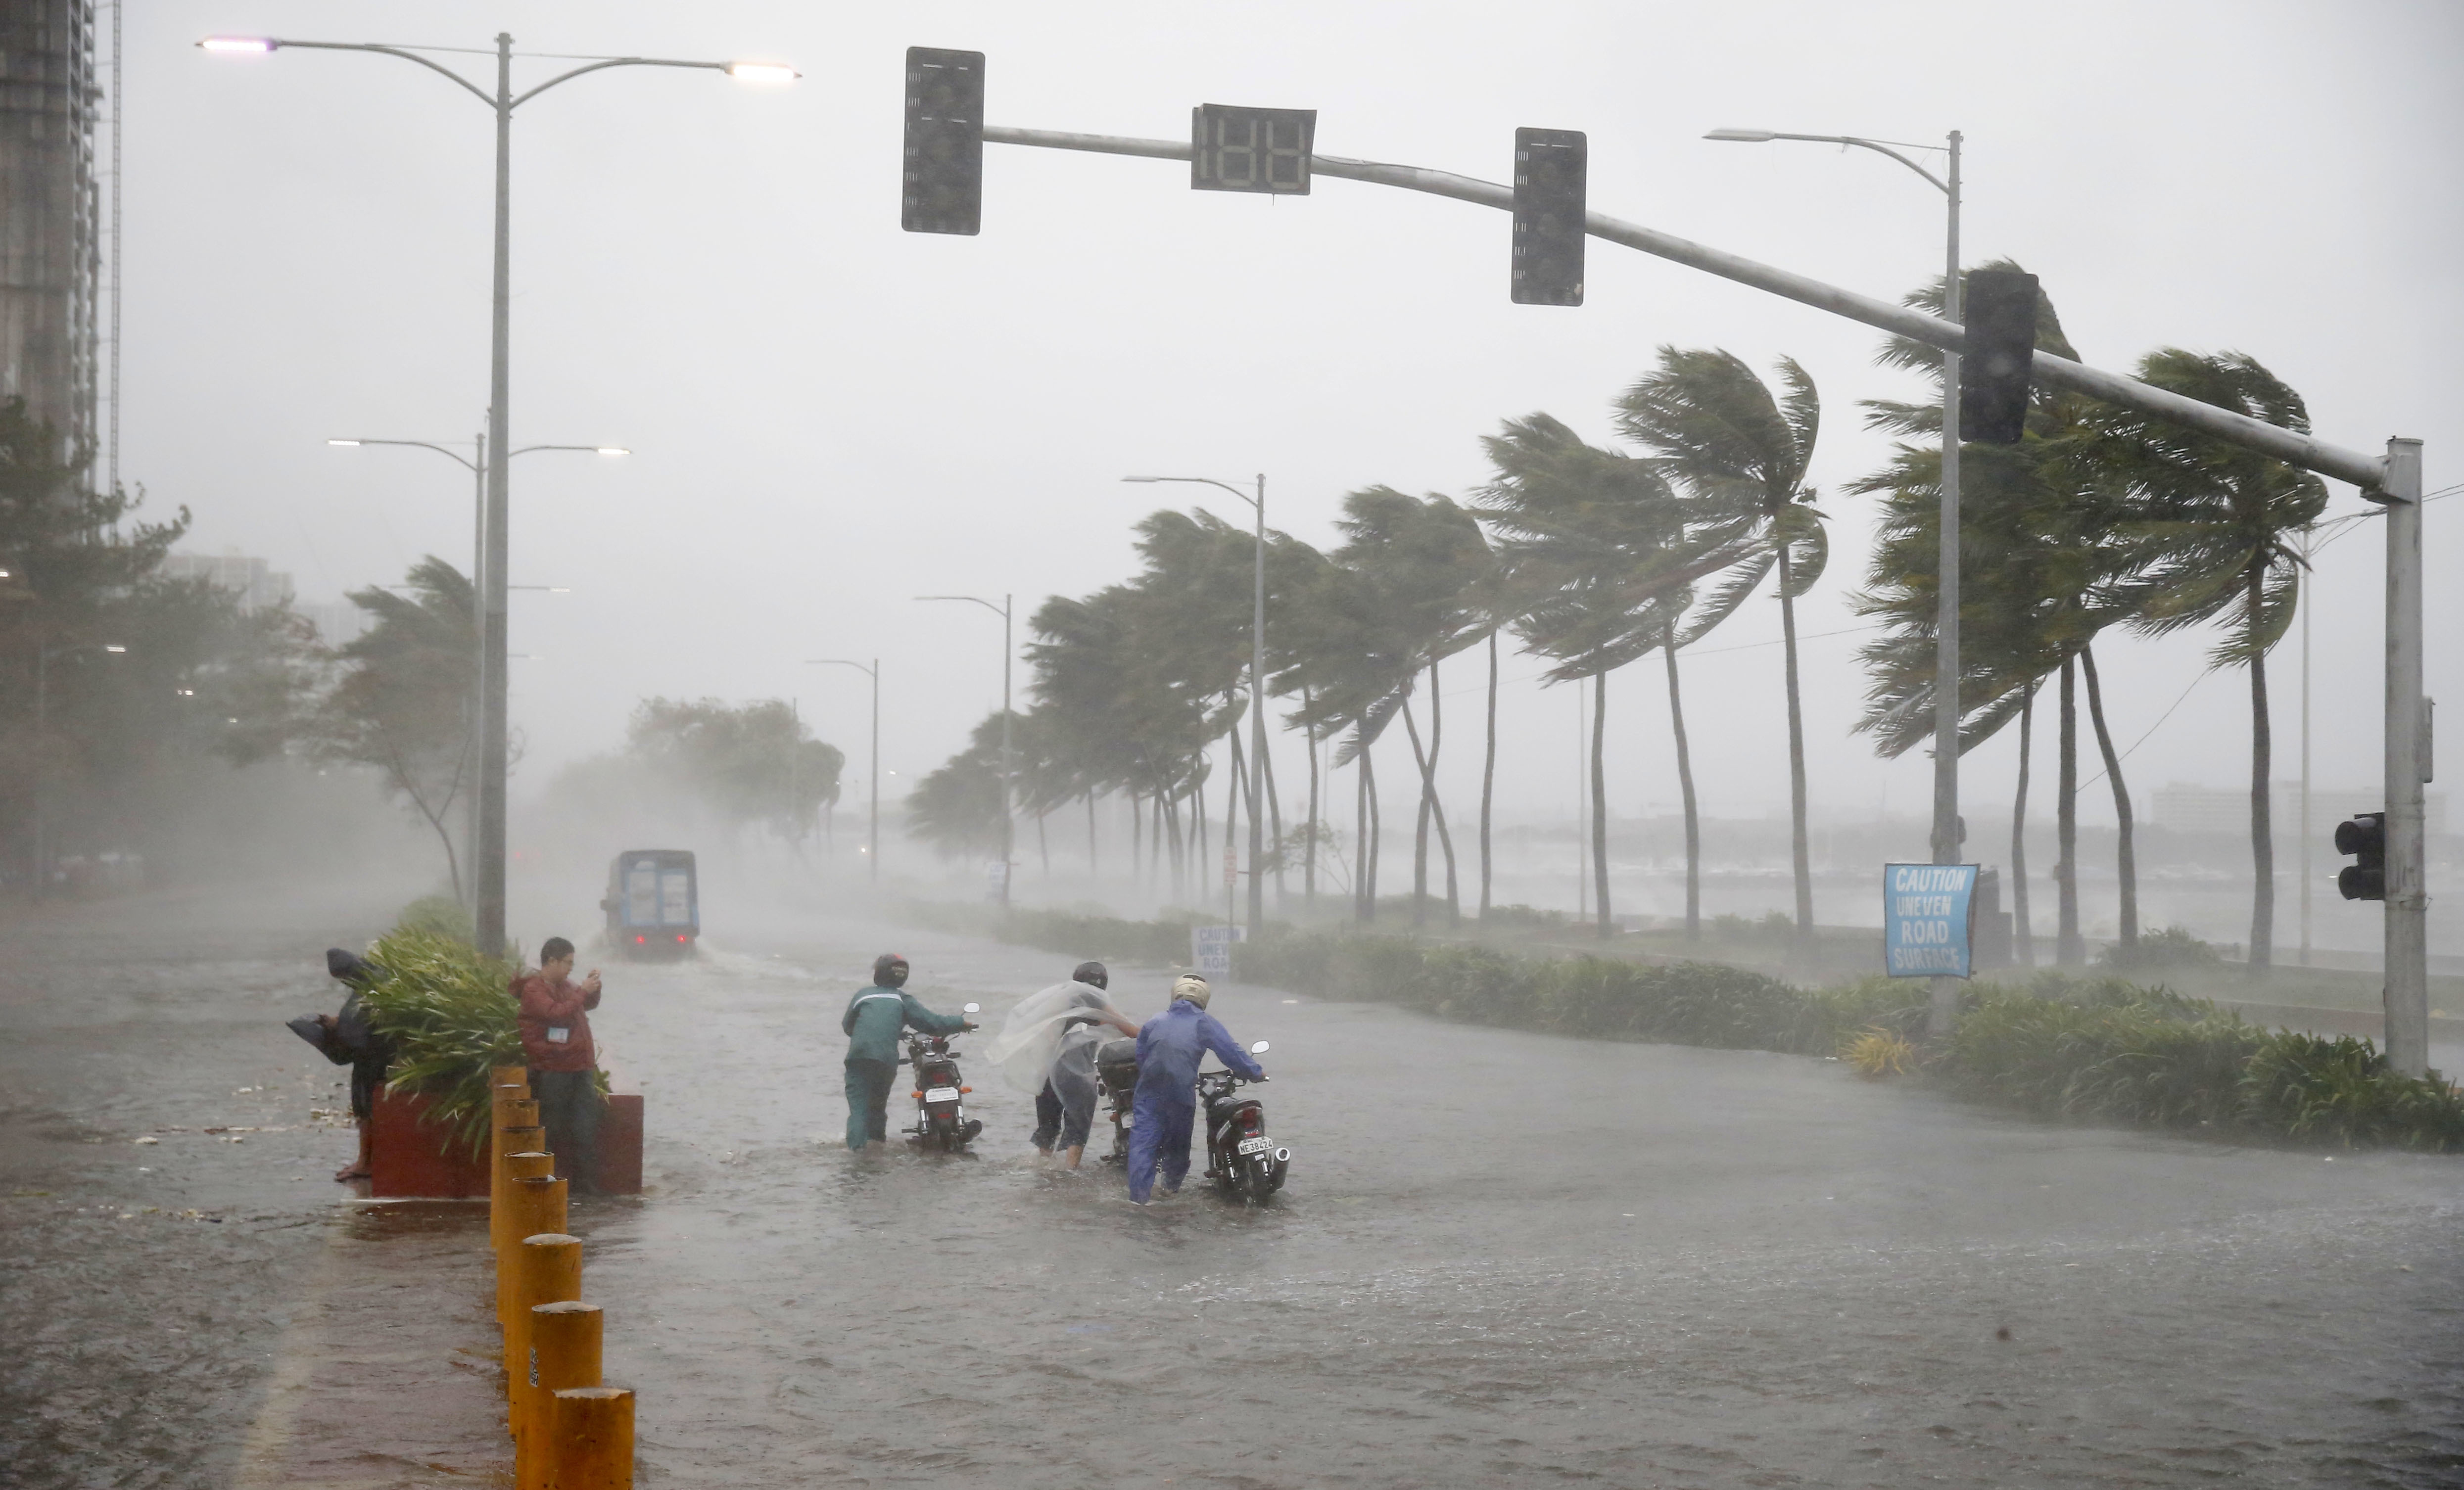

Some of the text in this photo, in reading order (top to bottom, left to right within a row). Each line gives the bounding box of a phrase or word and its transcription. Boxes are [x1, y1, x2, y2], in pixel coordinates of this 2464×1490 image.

[1896, 868, 1968, 891] CAUTION
[1896, 896, 1951, 916] UNEVEN
[1902, 921, 1948, 944] ROAD
[1895, 948, 1960, 970] SURFACE
[1240, 1140, 1272, 1153] NE38424
